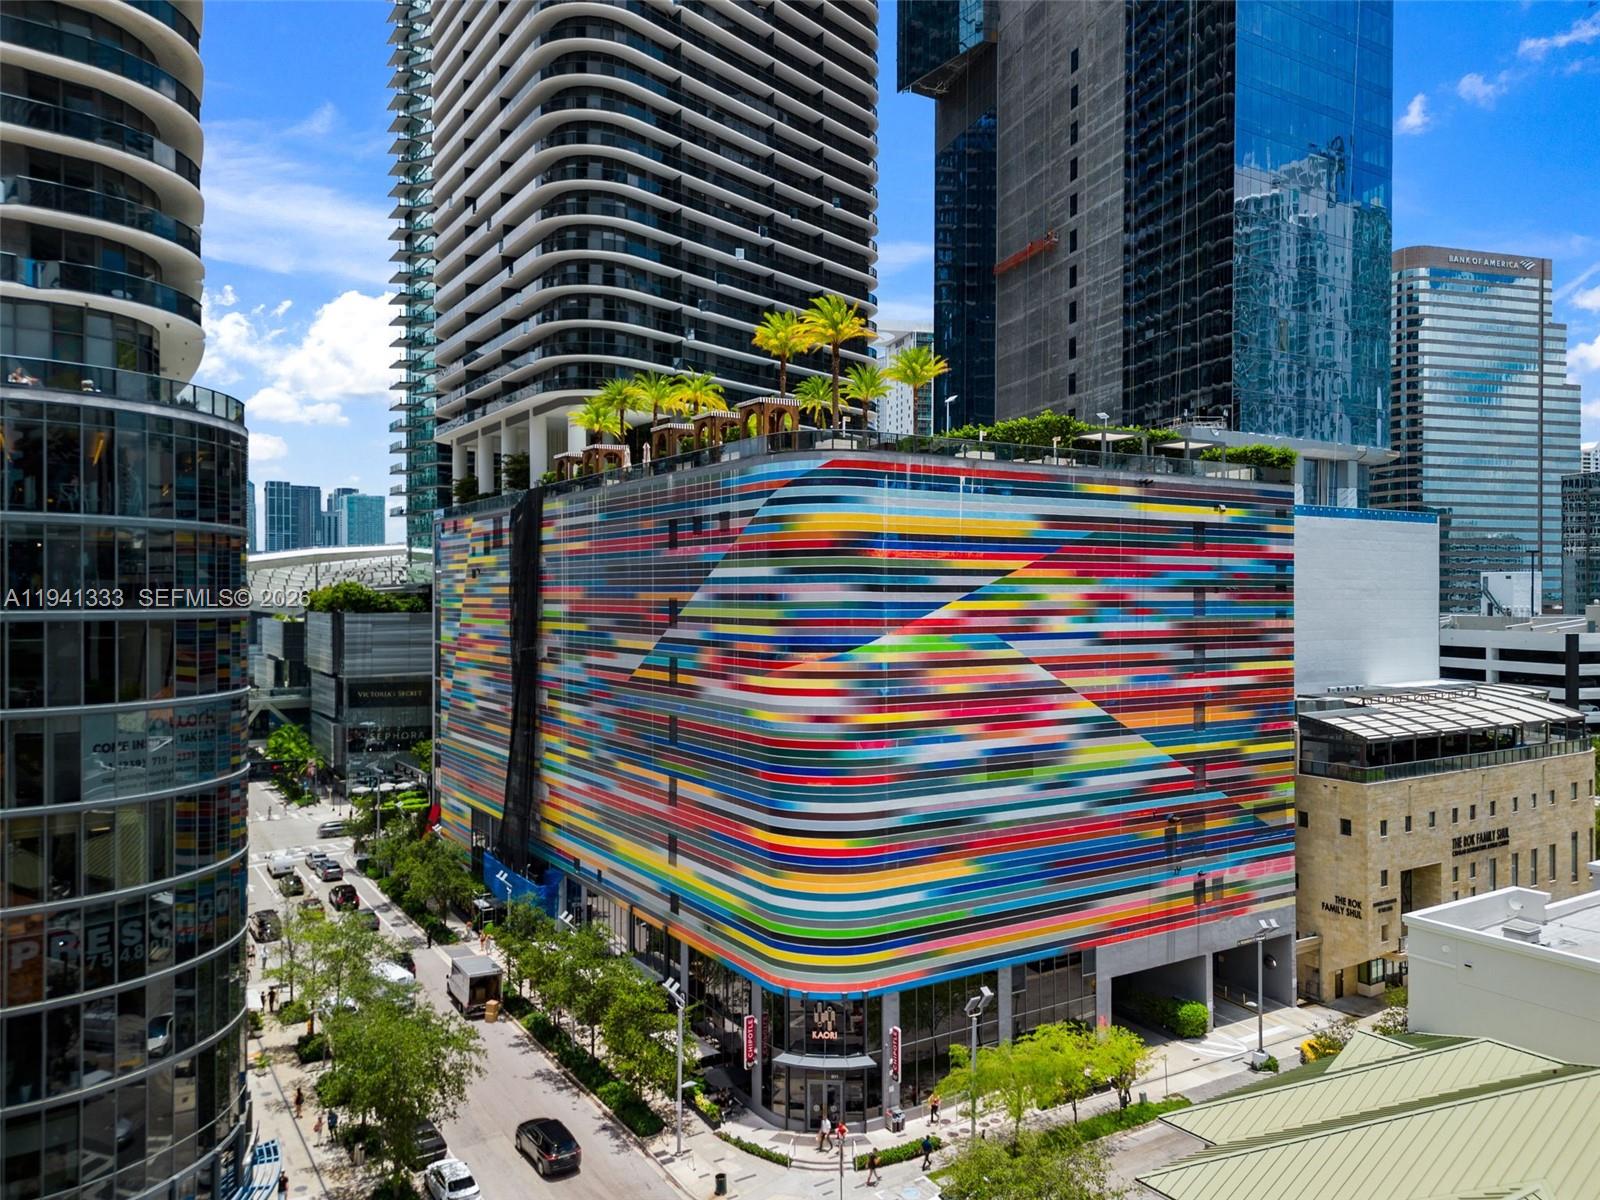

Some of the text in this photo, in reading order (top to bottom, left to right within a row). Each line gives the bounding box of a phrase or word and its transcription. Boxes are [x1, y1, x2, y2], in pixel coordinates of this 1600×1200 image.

[1449, 254, 1519, 270] BANK OF AMERICA
[369, 731, 425, 741] SEPHORA
[1452, 836, 1462, 849] THE
[1476, 829, 1496, 844] FAMILY
[1496, 827, 1509, 840] SHUL
[1335, 895, 1347, 905] THE
[1347, 898, 1362, 910] ROK
[1321, 902, 1362, 920] FAMILY SHUL
[812, 1031, 838, 1040] KAORI
